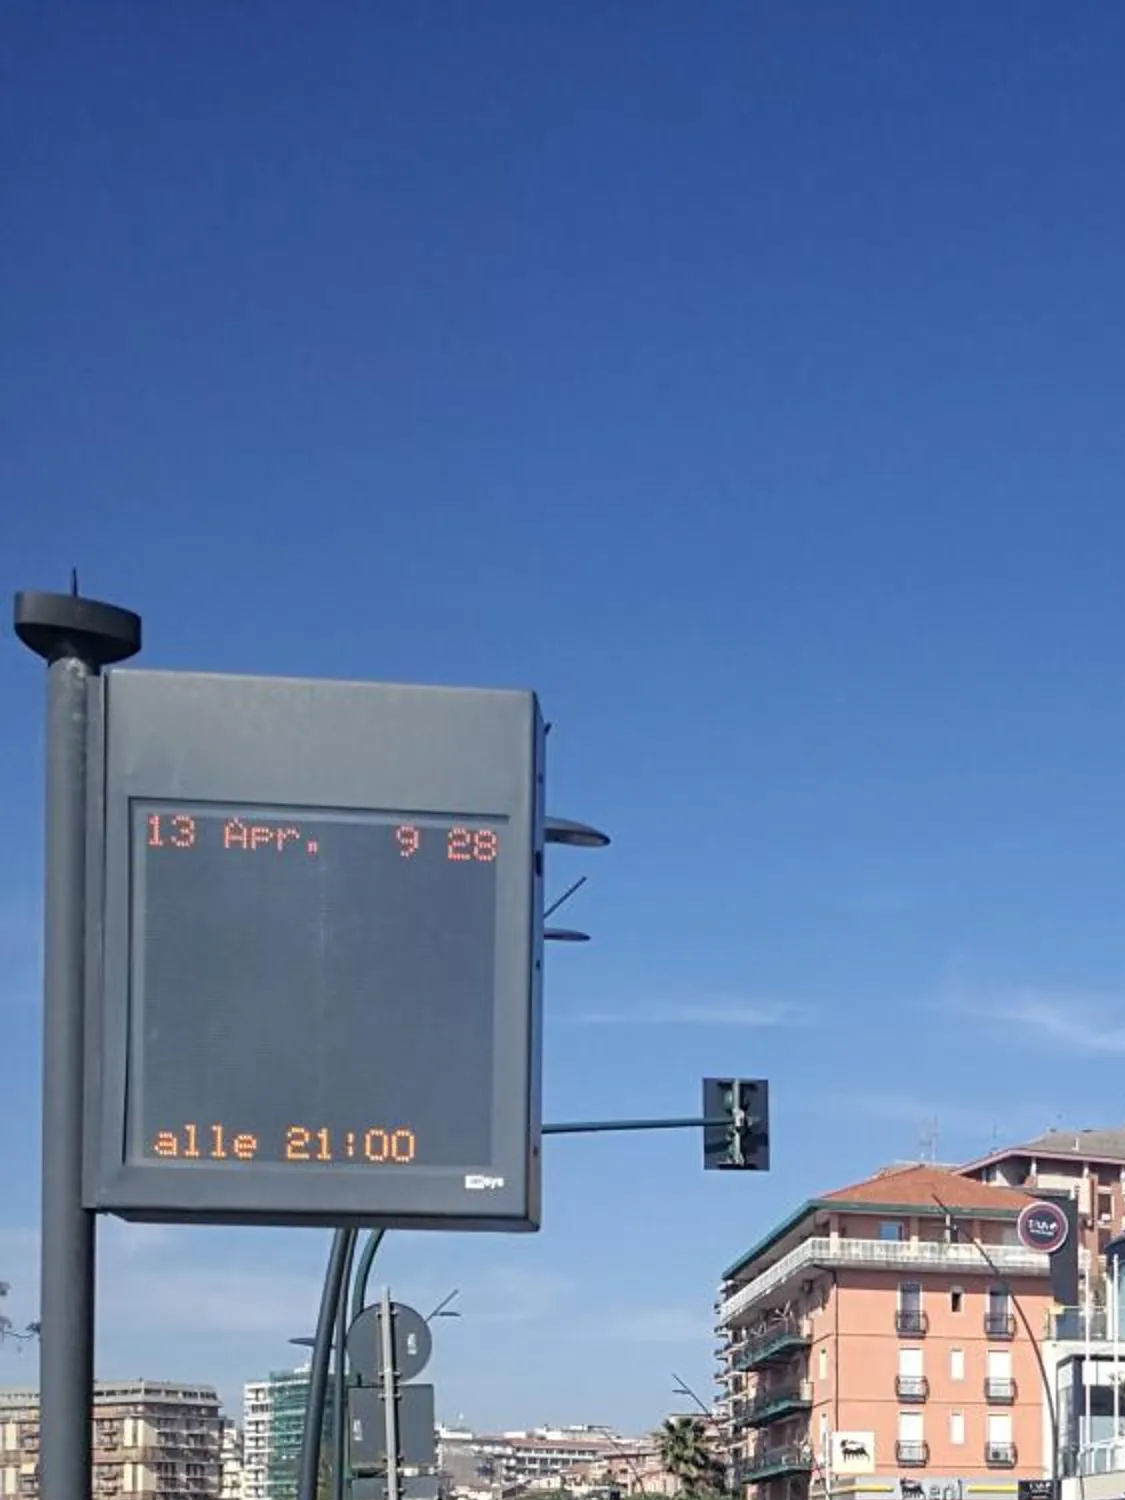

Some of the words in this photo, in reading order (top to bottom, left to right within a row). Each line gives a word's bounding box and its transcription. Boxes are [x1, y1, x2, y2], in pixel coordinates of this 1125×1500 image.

[148, 814, 195, 848] 13
[223, 818, 318, 854] Apr.
[397, 825, 419, 857] 9
[447, 826, 497, 861] 28
[154, 1124, 257, 1159] alle
[286, 1126, 415, 1162] 21:00
